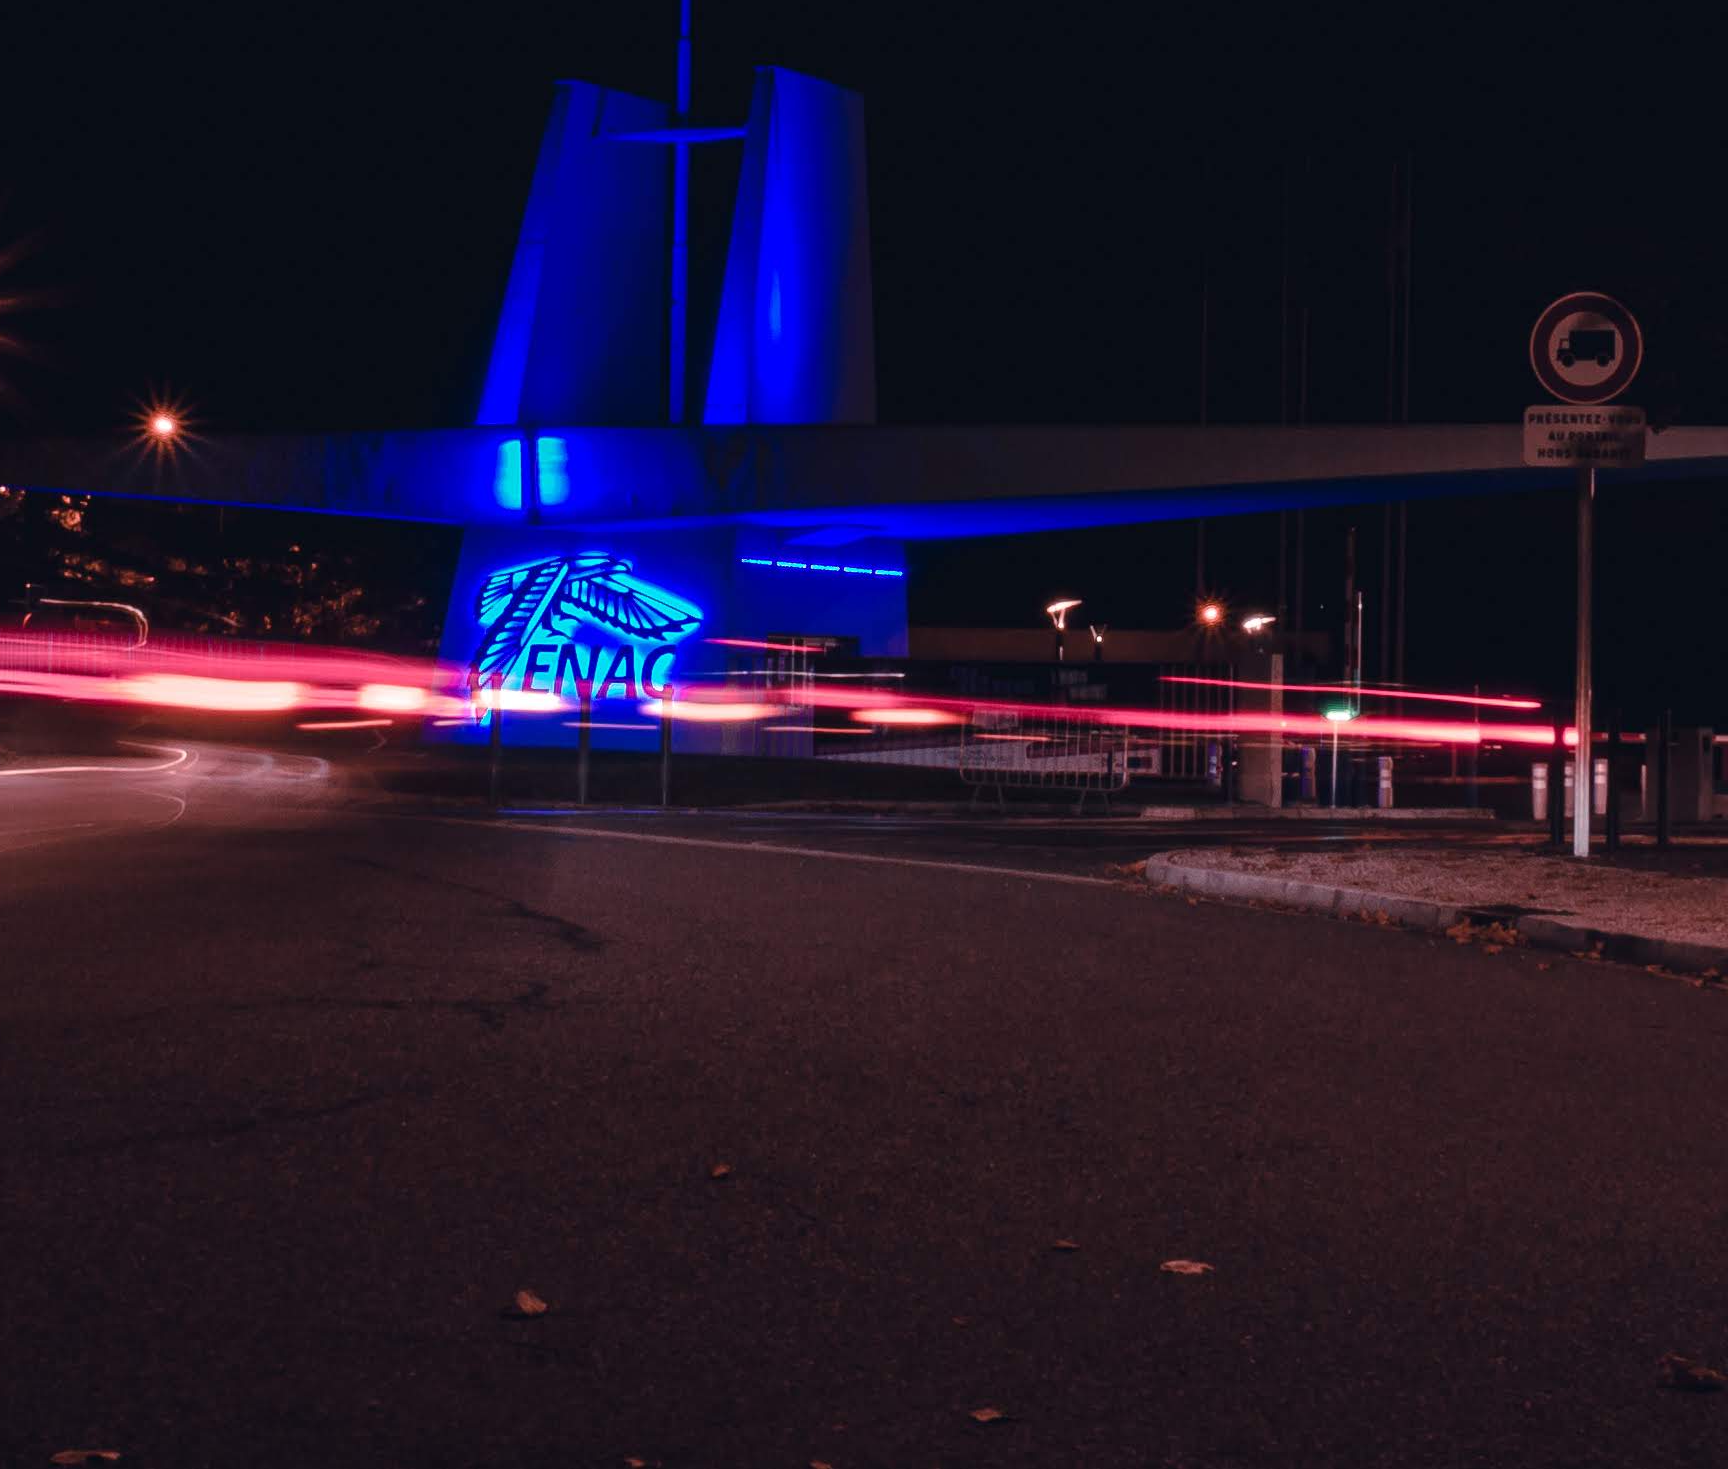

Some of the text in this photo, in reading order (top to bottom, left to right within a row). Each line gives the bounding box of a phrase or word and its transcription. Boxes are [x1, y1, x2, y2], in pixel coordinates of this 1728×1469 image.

[1548, 430, 1565, 442] AU
[1537, 447, 1572, 460] HORS
[521, 643, 678, 701] ENAC
